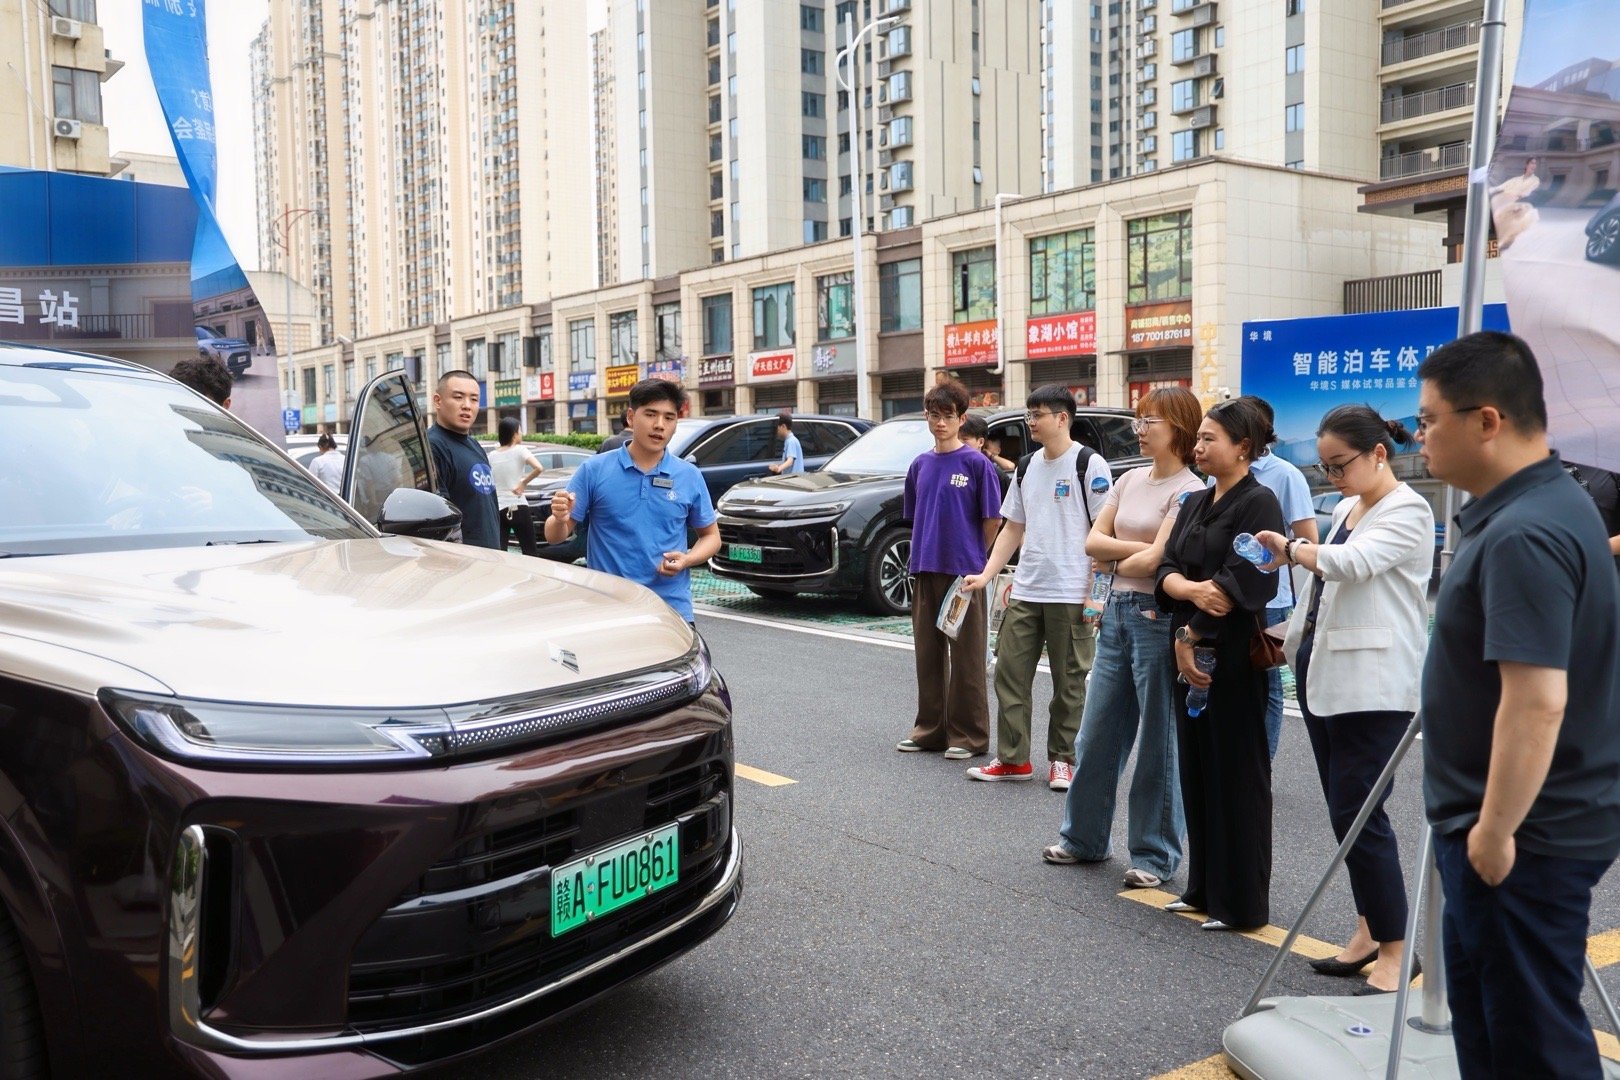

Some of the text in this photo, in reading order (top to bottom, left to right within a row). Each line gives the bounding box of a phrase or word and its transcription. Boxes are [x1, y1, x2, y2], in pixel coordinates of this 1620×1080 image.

[1029, 320, 1078, 344] 象湖小馆
[1310, 380, 1337, 391] 华境S
